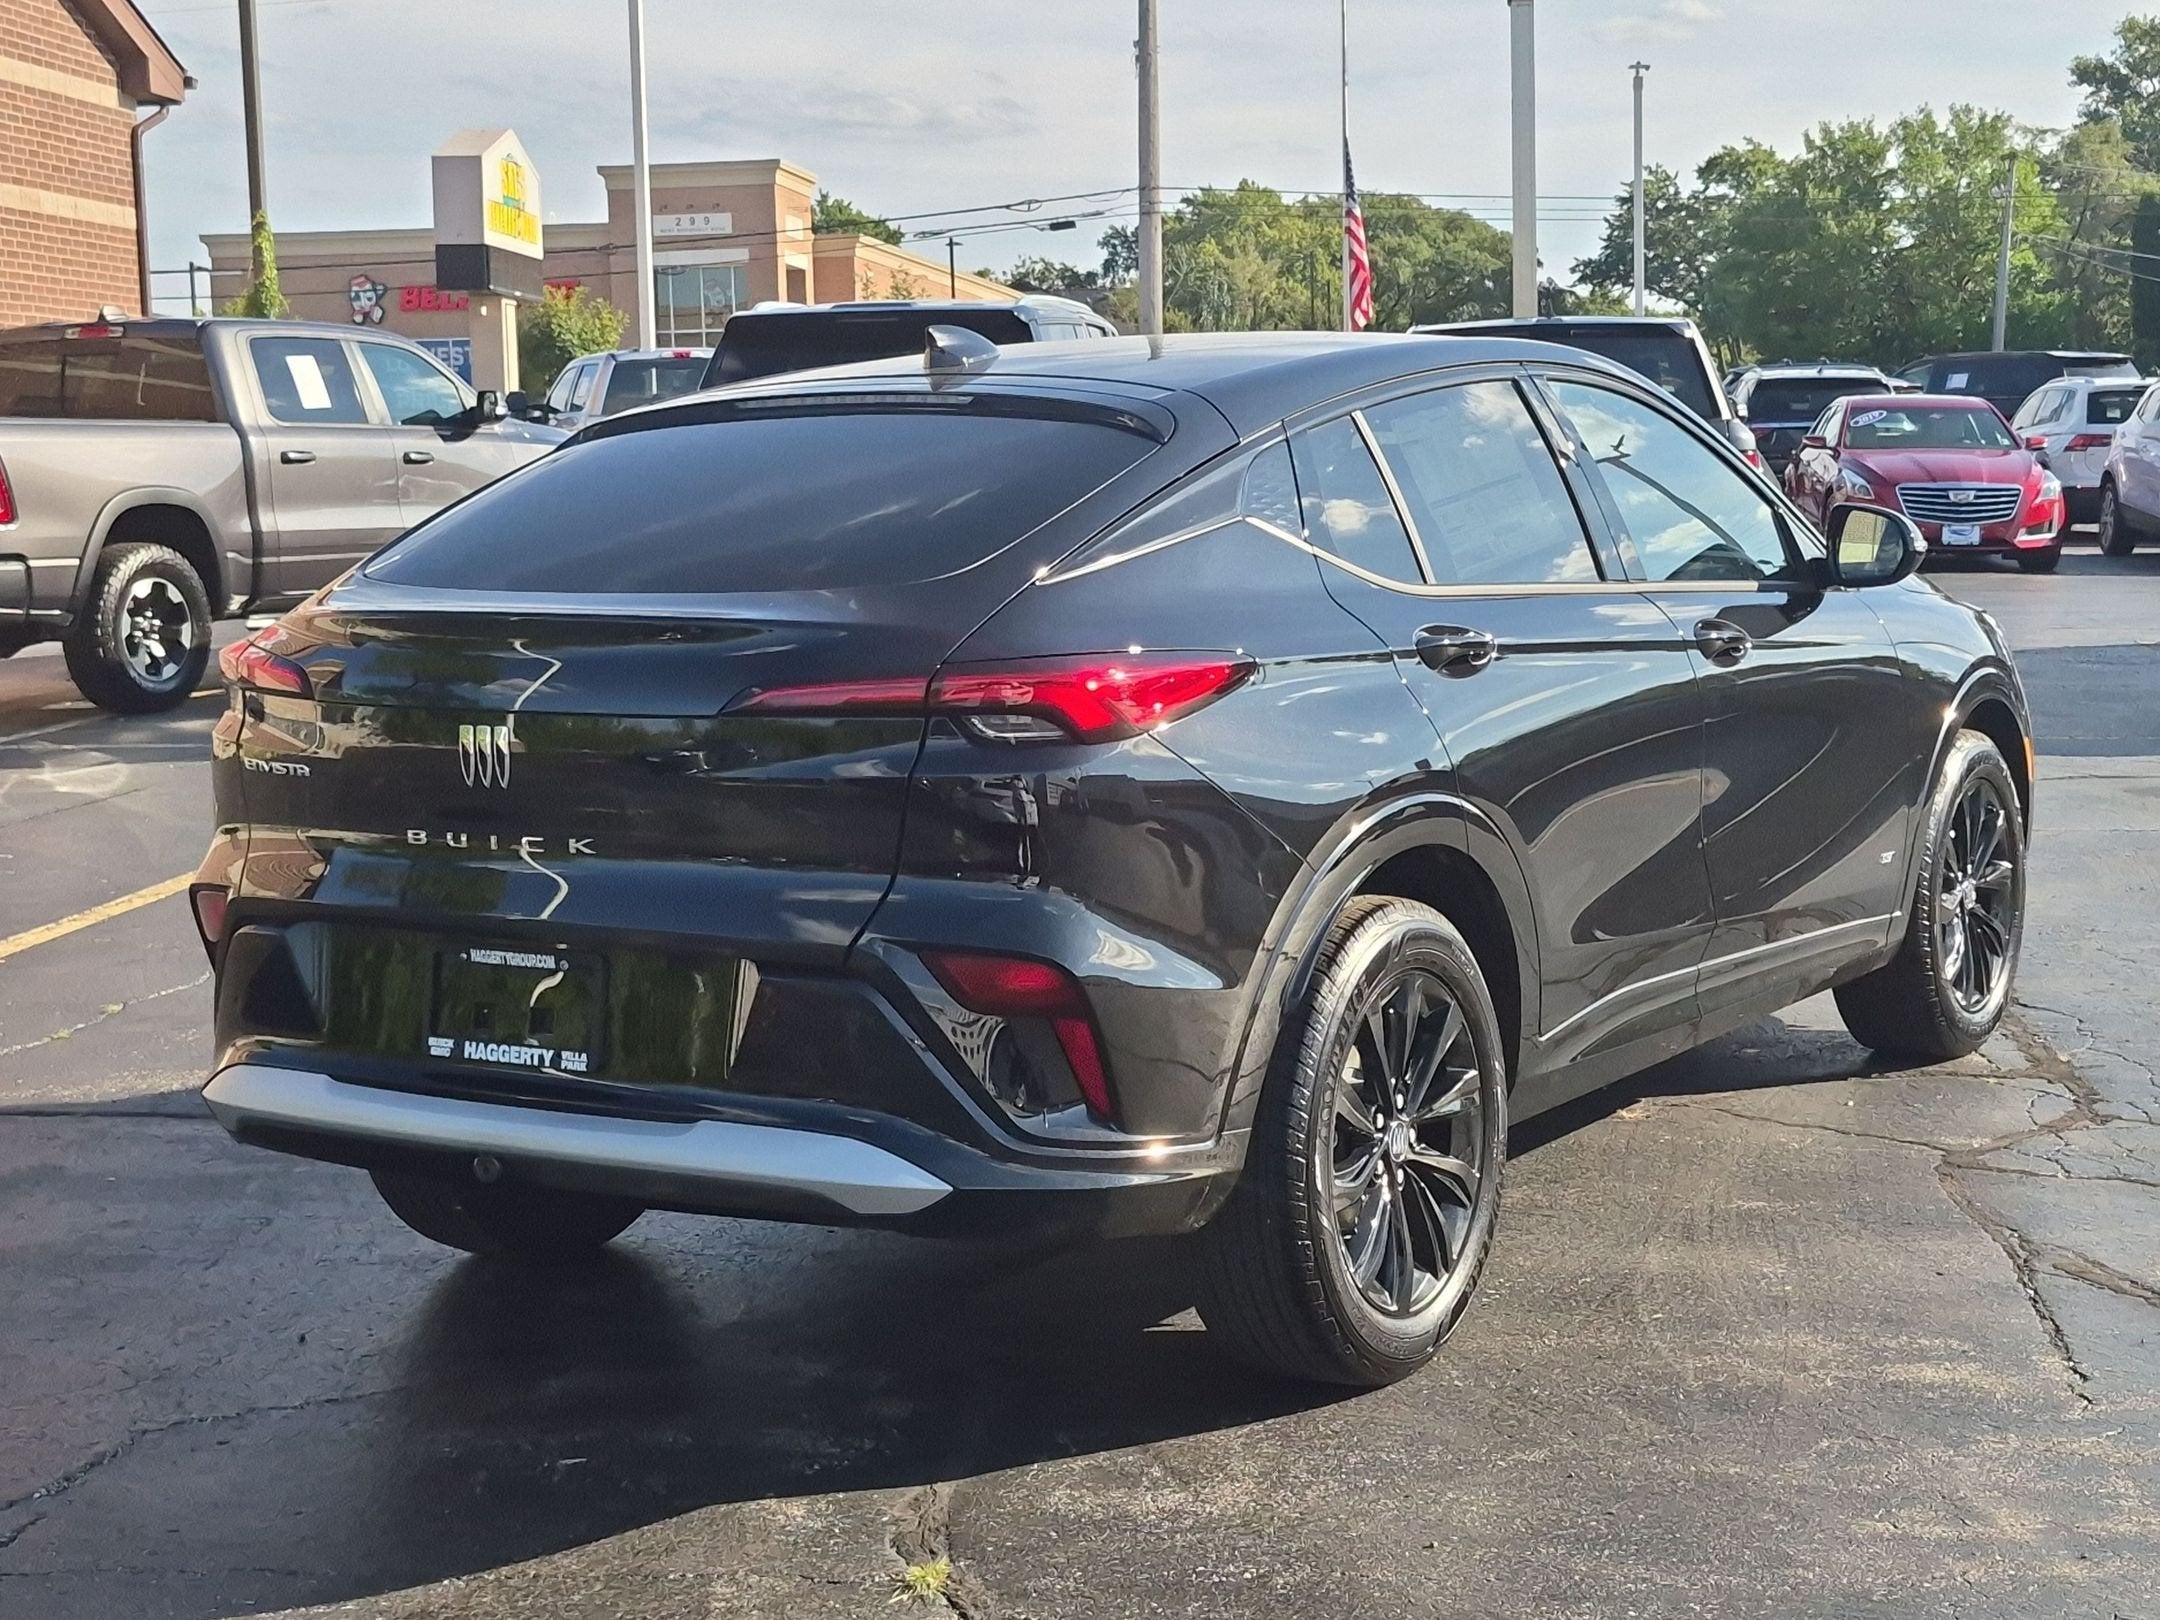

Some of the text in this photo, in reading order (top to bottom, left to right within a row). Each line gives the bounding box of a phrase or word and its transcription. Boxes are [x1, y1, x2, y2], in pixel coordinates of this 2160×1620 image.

[675, 216, 710, 226] 299
[243, 757, 310, 777] ENVISTA
[406, 829, 597, 854] BUICK
[469, 948, 556, 969] HAGGERTYGROUP.COM
[463, 1040, 554, 1067] HAGGERTY
[560, 1050, 588, 1062] VILLA
[560, 1059, 588, 1072] PARK
